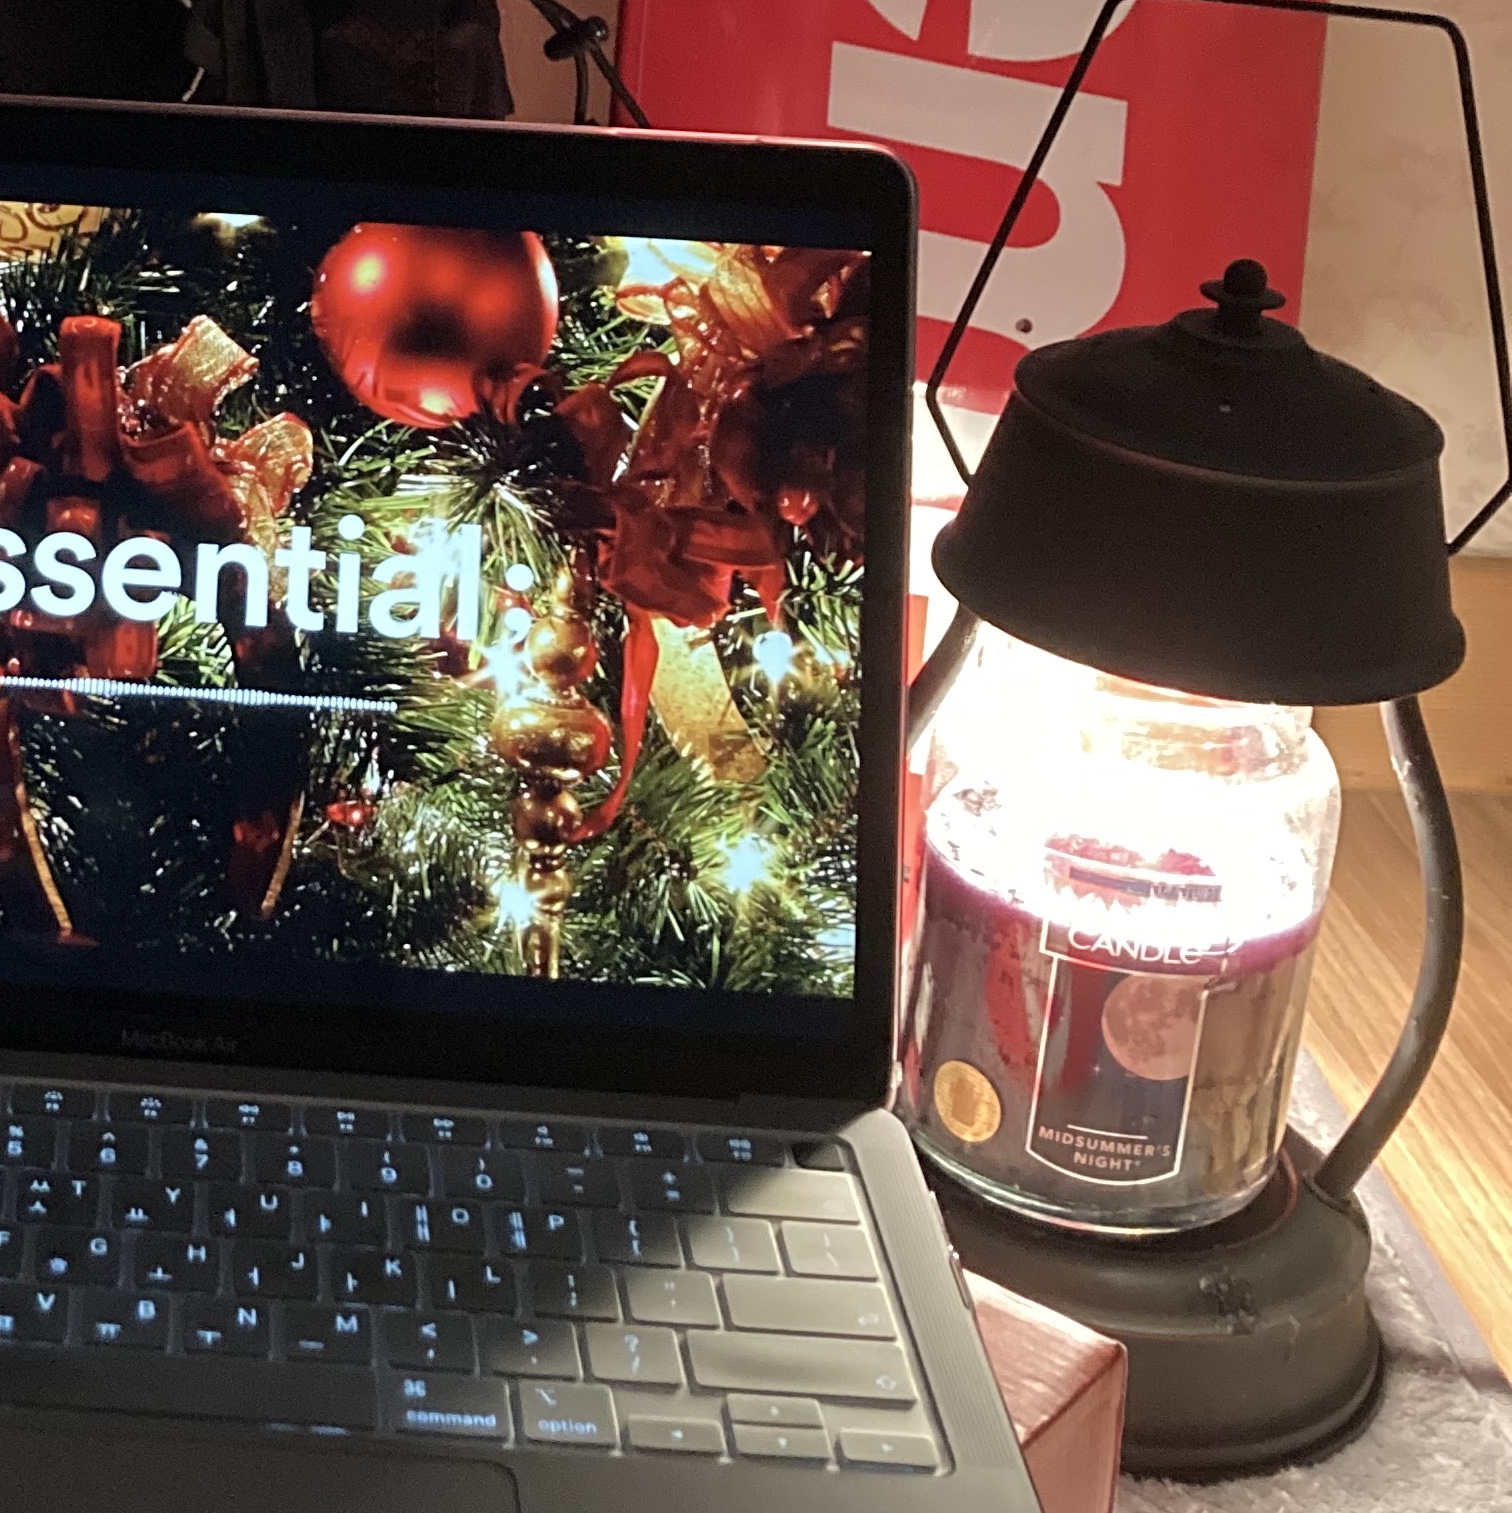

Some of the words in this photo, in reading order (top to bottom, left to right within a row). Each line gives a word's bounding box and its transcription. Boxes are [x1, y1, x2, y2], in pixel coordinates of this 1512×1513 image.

[1038, 1125, 1171, 1157] MIDSUMMER'S
[72, 1180, 86, 1196] T
[166, 1187, 181, 1203] Y
[260, 1194, 278, 1210] U
[547, 1215, 564, 1230] P
[89, 1238, 107, 1255] G
[187, 1245, 206, 1261] H
[291, 1253, 304, 1269] J
[384, 1259, 402, 1275] K
[485, 1266, 501, 1282] L
[36, 1293, 55, 1310] V
[236, 1307, 257, 1325] N
[335, 1314, 358, 1331] M
[406, 1410, 497, 1427] command
[538, 1420, 597, 1435] option
